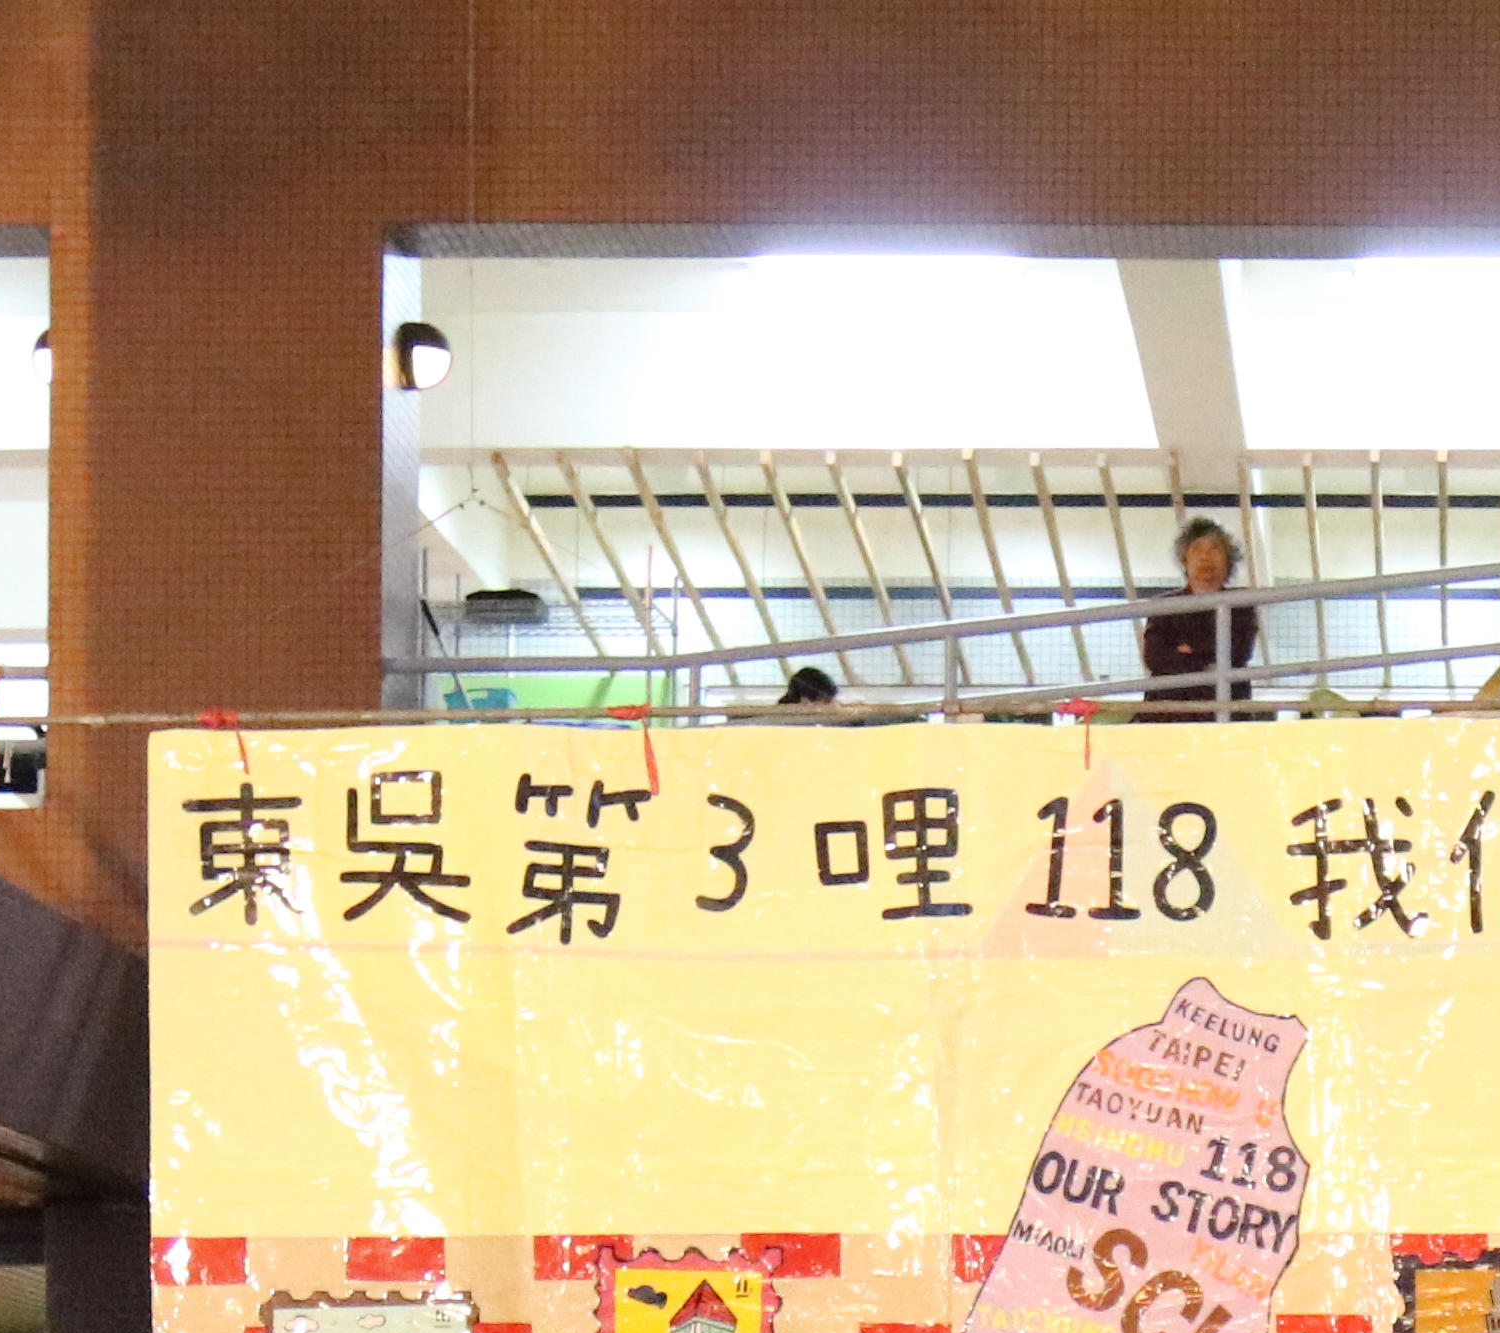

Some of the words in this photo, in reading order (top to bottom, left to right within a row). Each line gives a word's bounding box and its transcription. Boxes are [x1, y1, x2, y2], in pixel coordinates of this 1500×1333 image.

[1175, 998, 1281, 1053] KEELUNG
[1148, 1029, 1246, 1081] TAIPEI
[1074, 1083, 1204, 1135] TAOYUAN
[1199, 1135, 1298, 1192] 118
[1032, 1151, 1125, 1216] OUR
[1150, 1181, 1298, 1254] STORY
